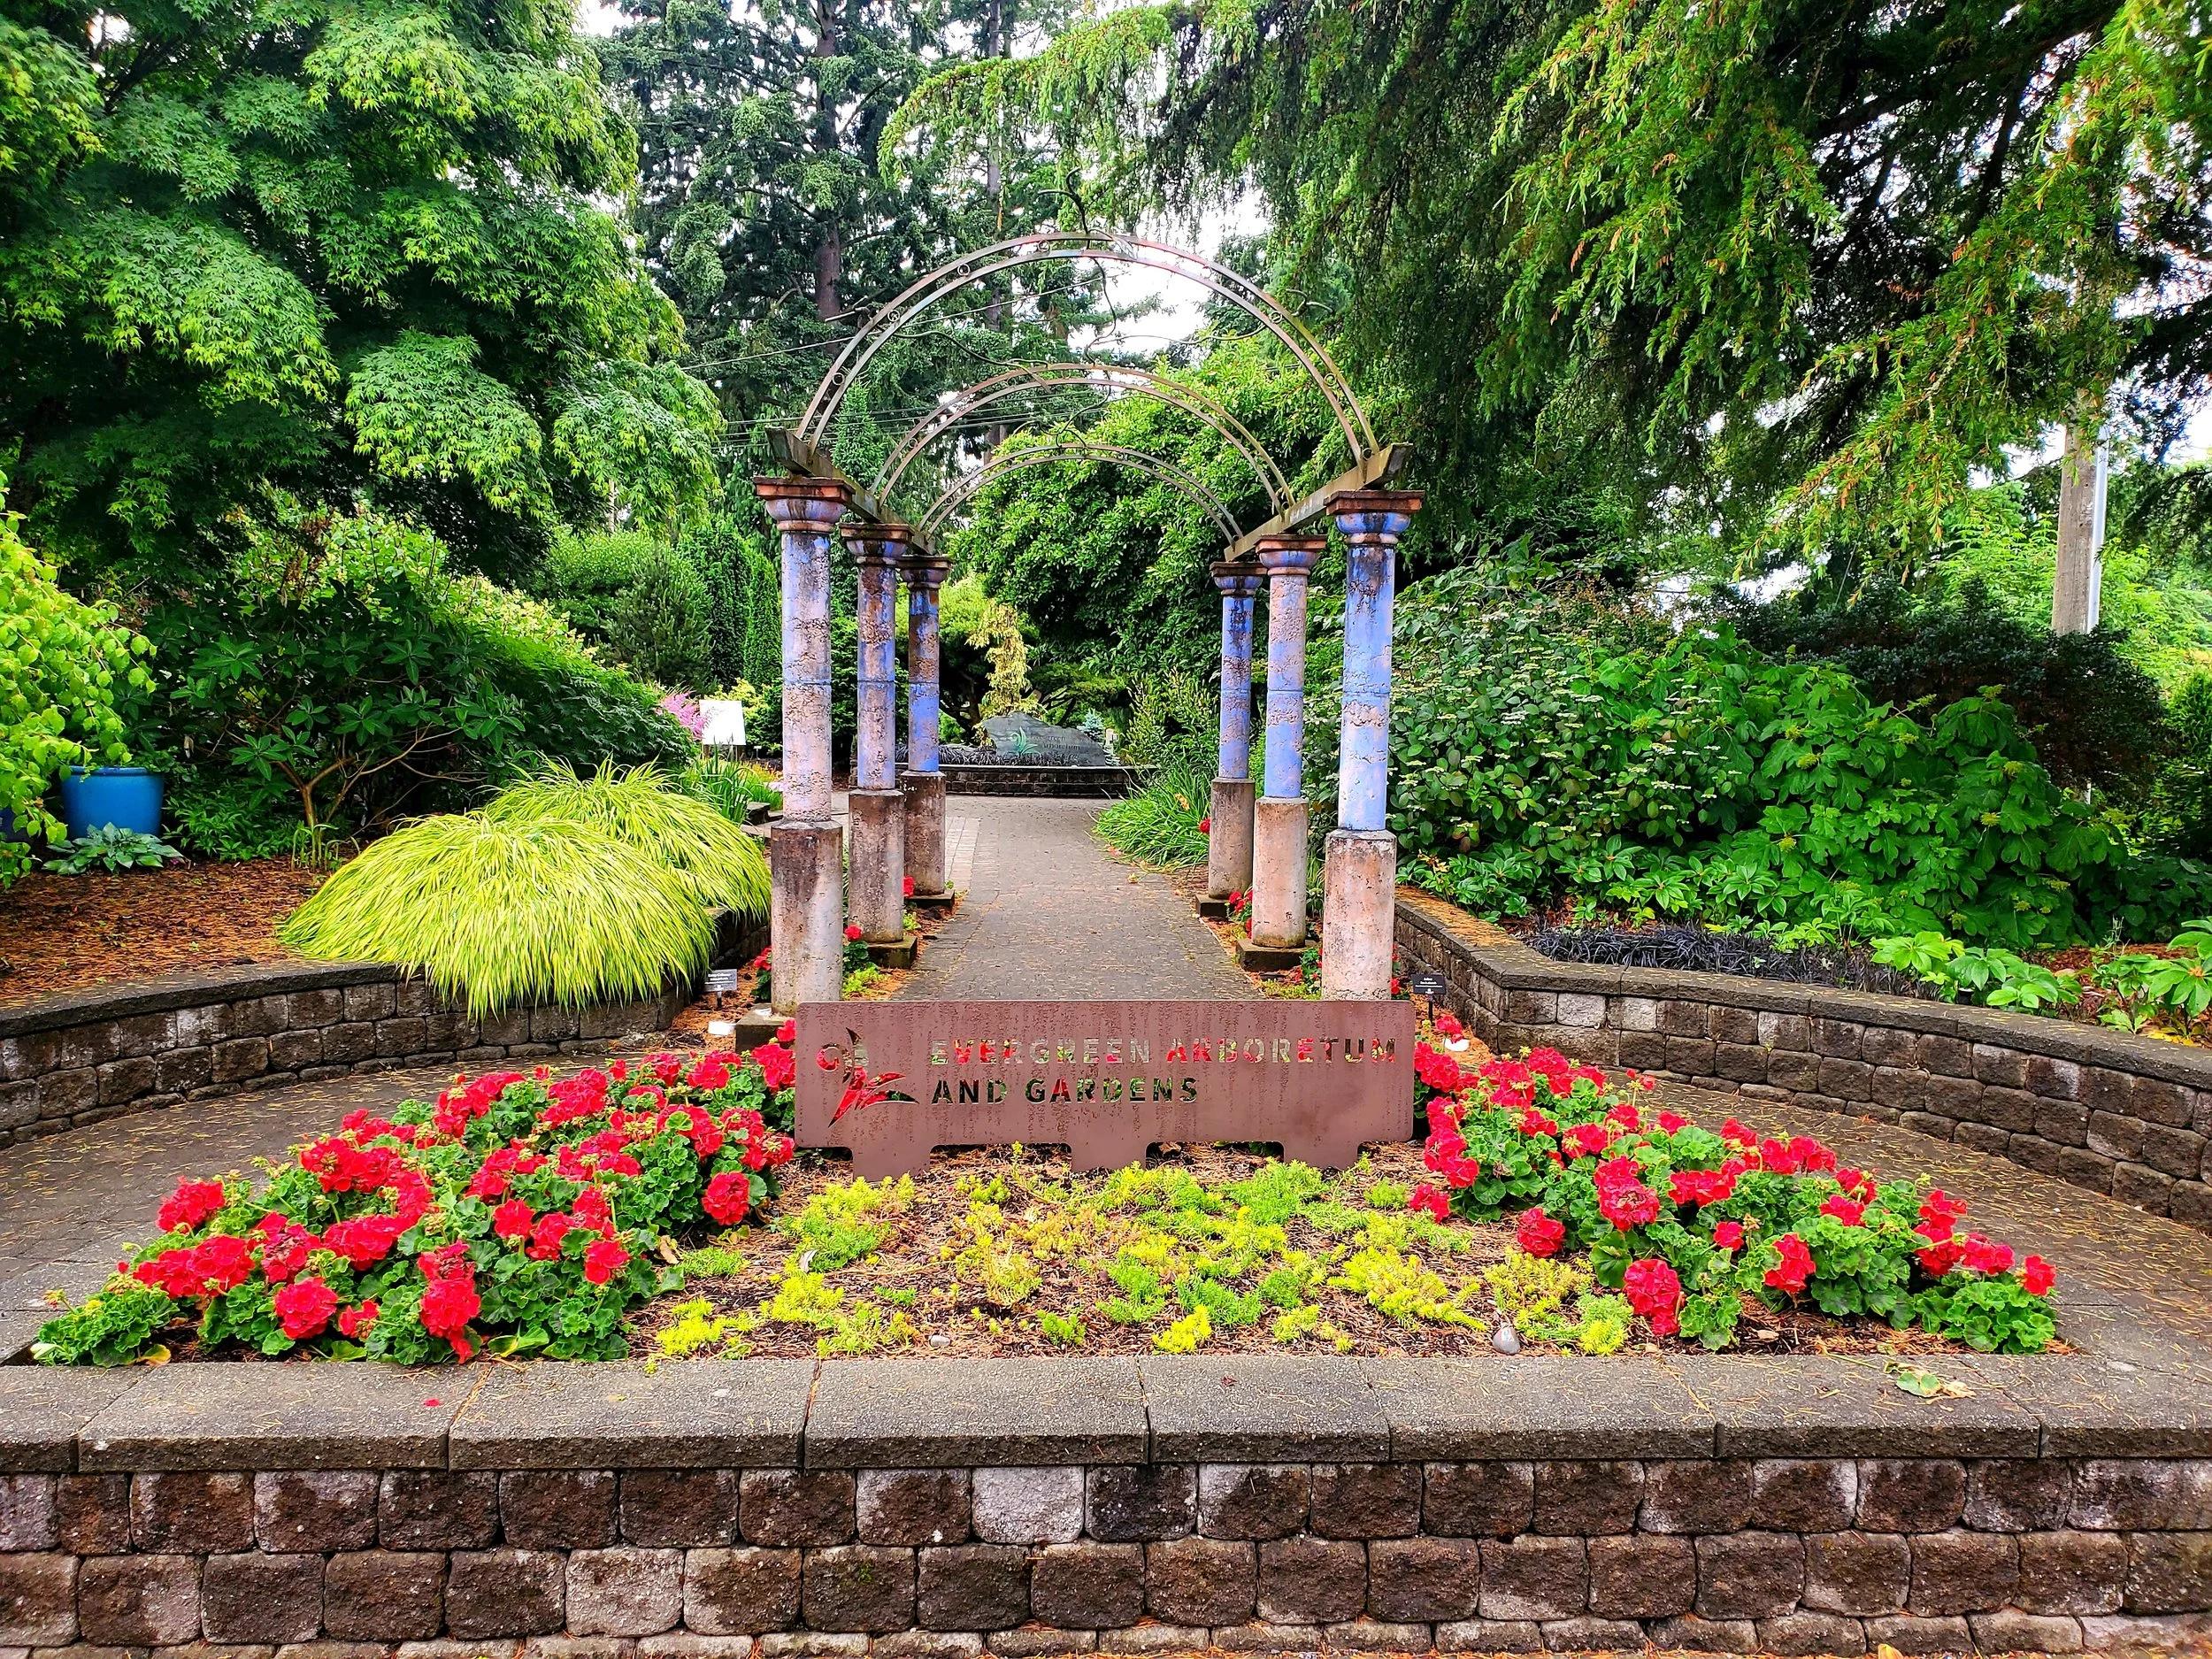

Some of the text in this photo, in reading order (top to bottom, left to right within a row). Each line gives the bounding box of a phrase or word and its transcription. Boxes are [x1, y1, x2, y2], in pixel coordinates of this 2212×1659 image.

[931, 1038, 1396, 1064] EVERGREEN ARBORETUM
[931, 1076, 1198, 1104] AND GARDENS
